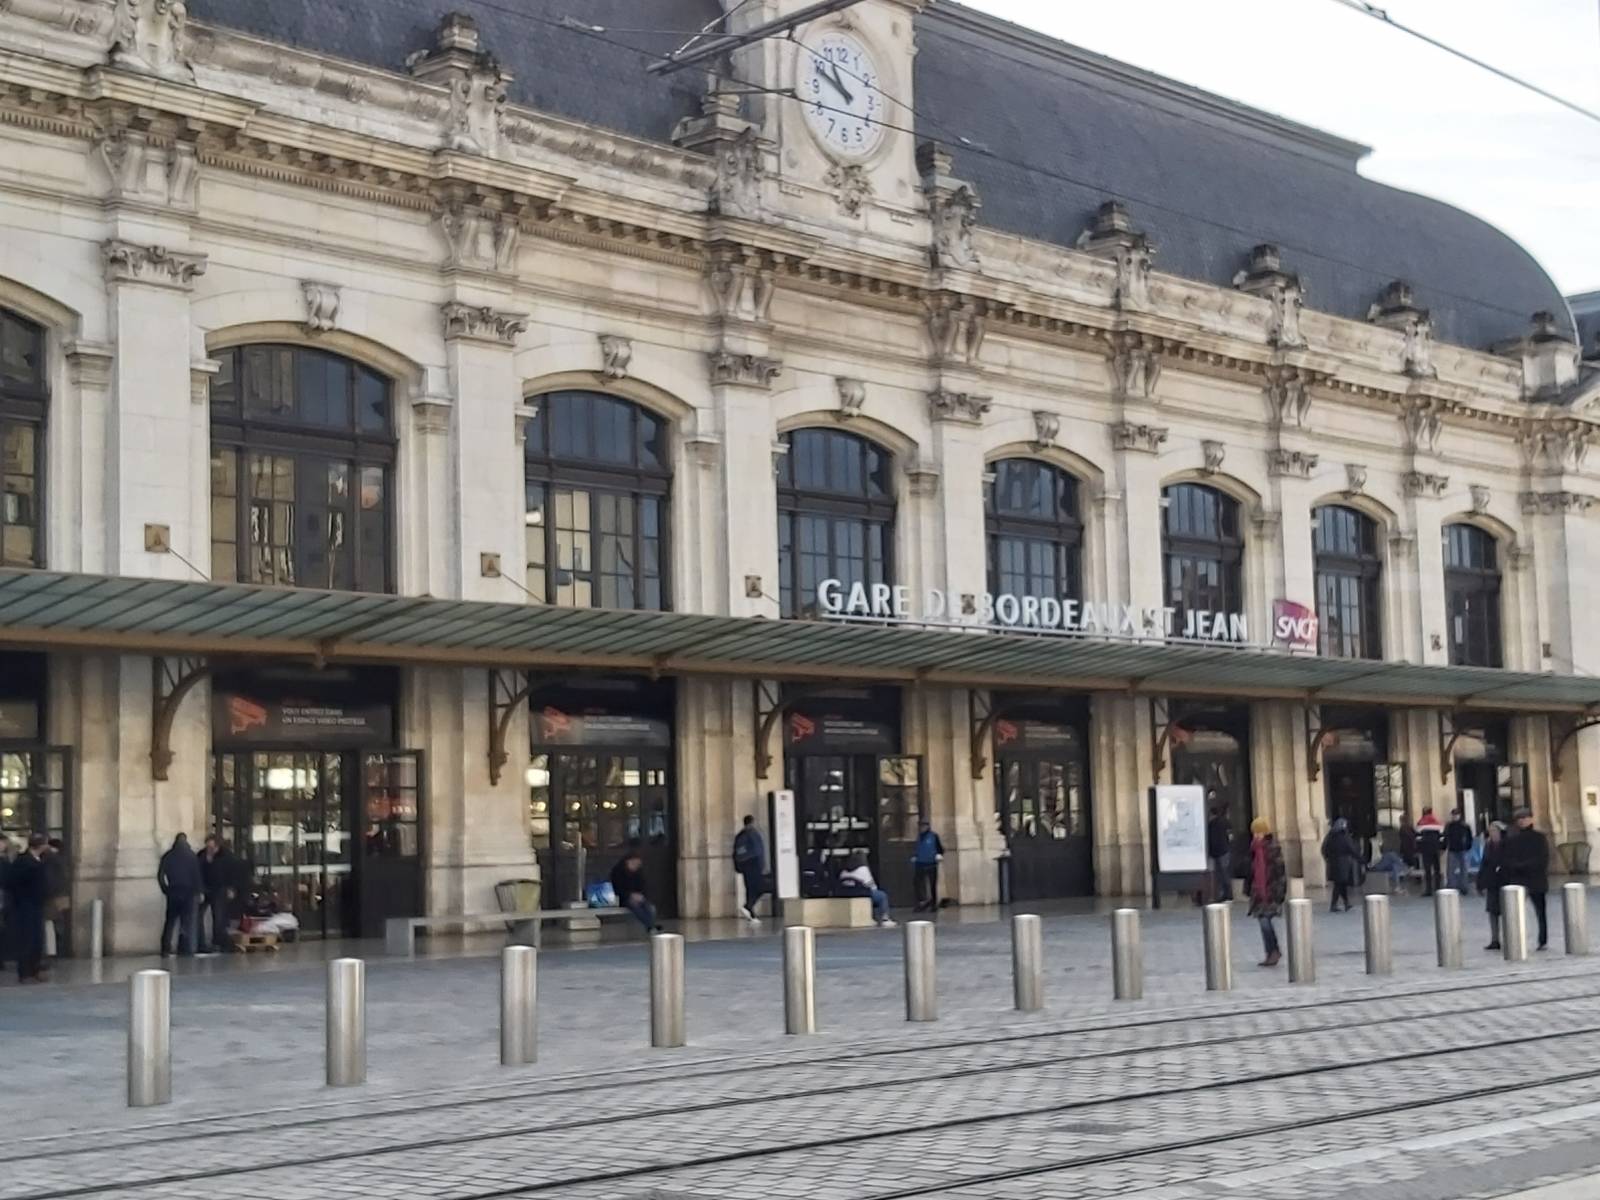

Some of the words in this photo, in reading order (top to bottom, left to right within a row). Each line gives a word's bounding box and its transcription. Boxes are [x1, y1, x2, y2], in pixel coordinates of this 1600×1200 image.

[823, 47, 833, 62] 11
[836, 47, 849, 64] 12
[814, 59, 825, 75] 10
[812, 78, 820, 94] 9
[816, 101, 824, 116] 8
[867, 95, 874, 111] 3
[827, 117, 836, 137] 7
[841, 127, 848, 143] 6
[855, 127, 862, 142] 5
[818, 578, 911, 616] GARE
[978, 592, 1136, 632] BORDEAUX
[1146, 606, 1176, 637] ST
[1182, 609, 1249, 641] JEAN
[1275, 616, 1319, 640] SNCF
